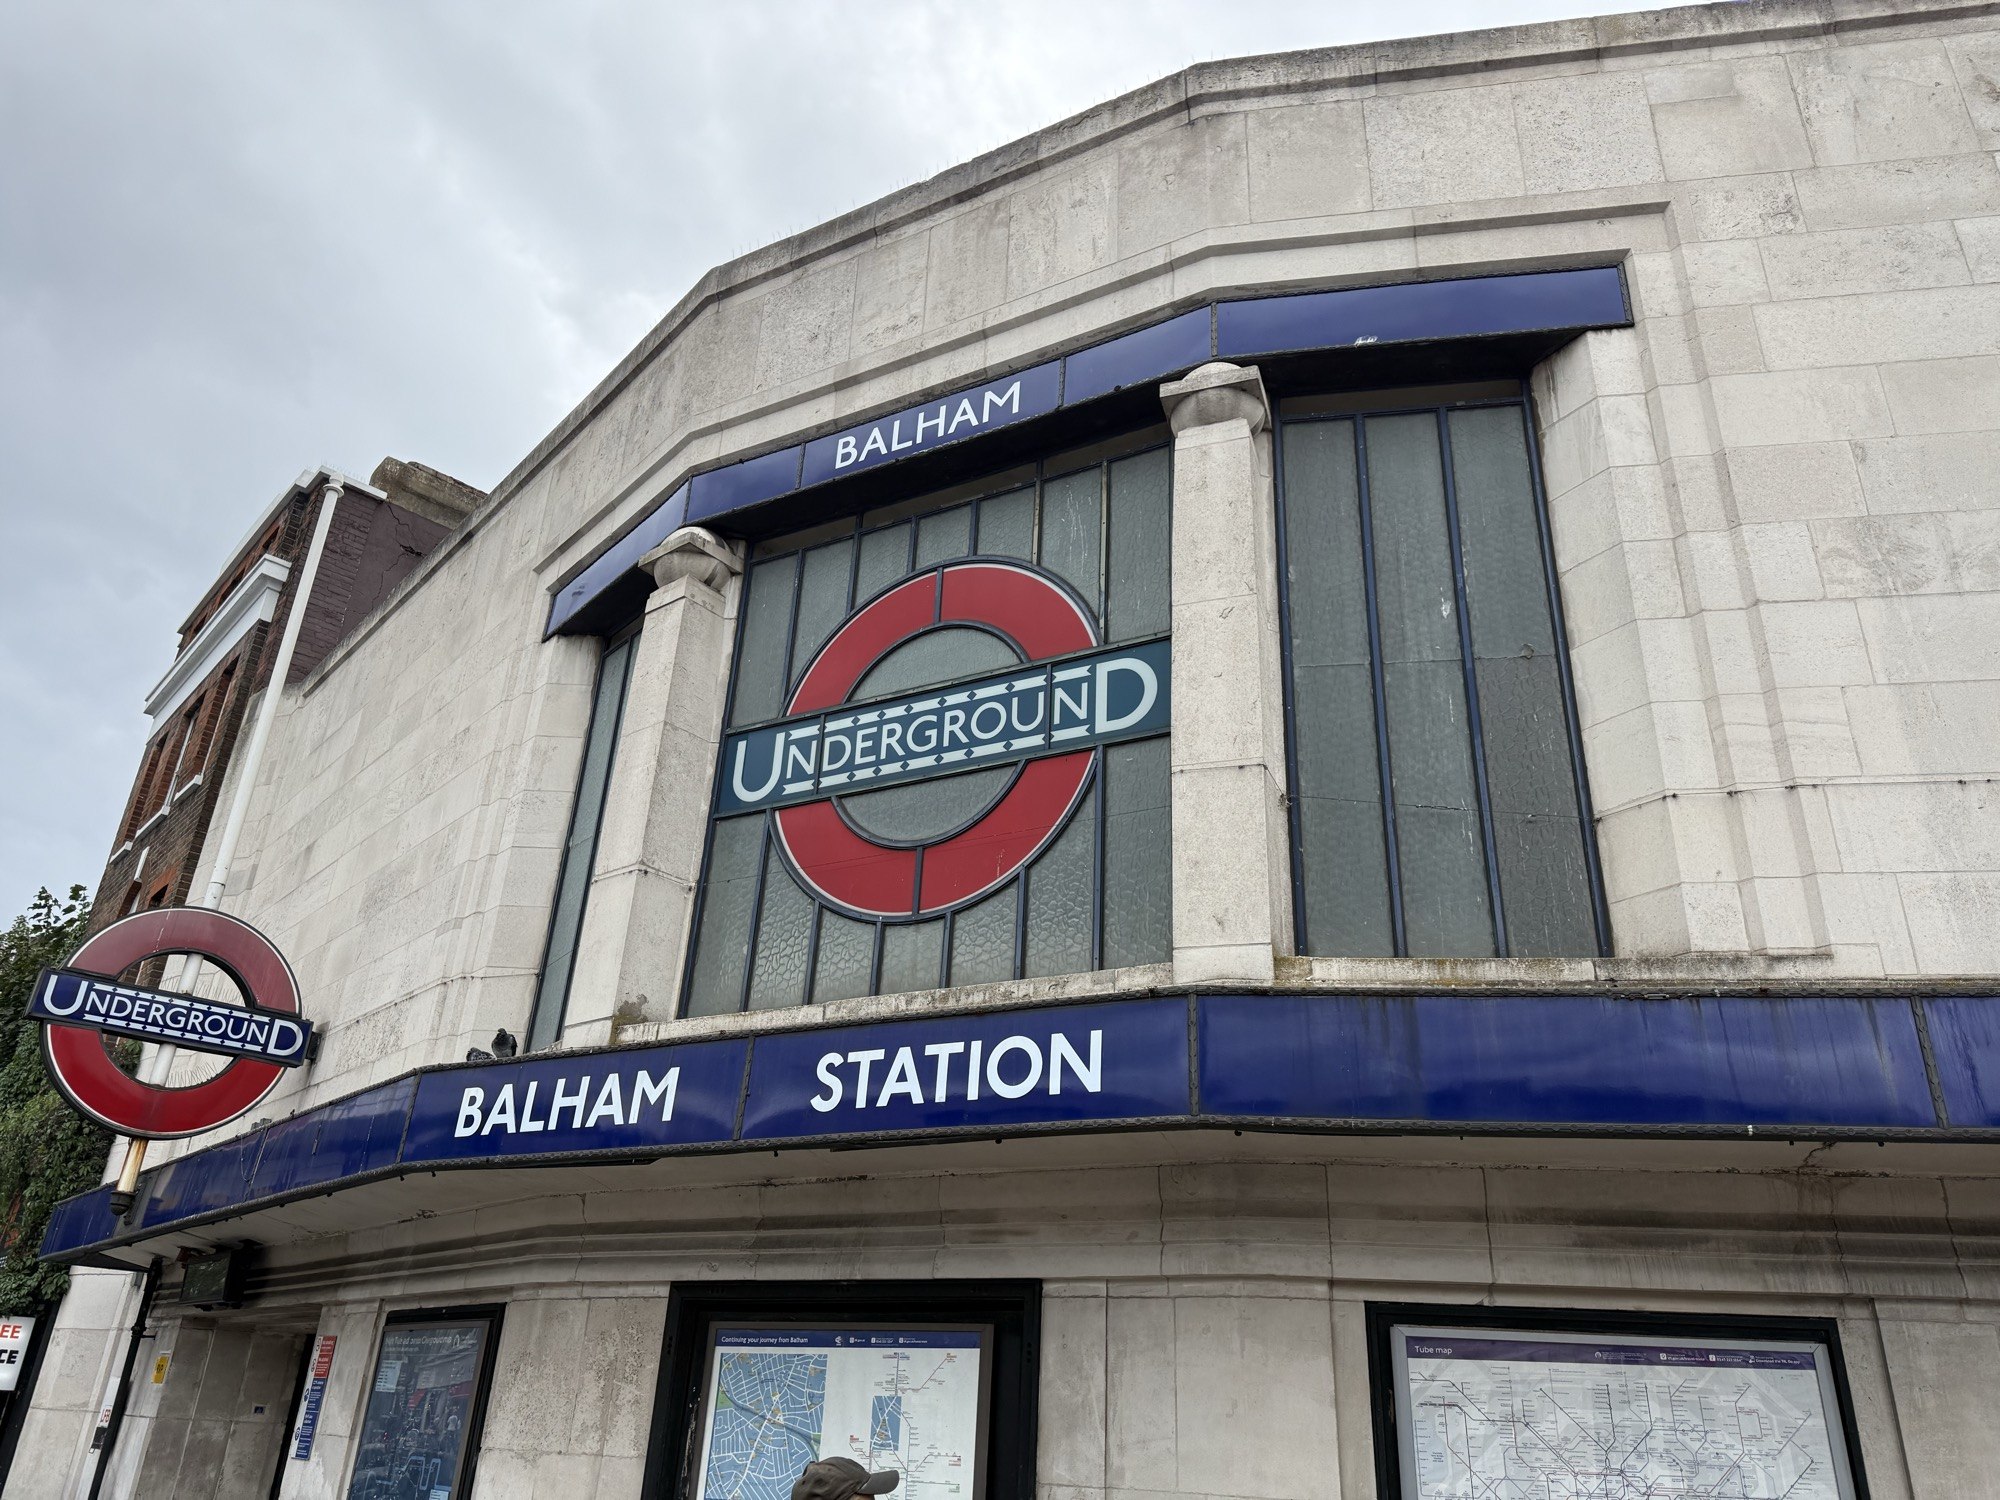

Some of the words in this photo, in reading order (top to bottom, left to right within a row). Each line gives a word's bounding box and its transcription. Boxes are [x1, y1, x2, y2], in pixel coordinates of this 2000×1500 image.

[835, 380, 1021, 469] BALHAM
[732, 657, 1158, 803] UNDERGROUND
[43, 974, 303, 1056] UNDERGROUND
[454, 1066, 680, 1138] BALHAM
[810, 1029, 1102, 1112] STATION
[0, 1324, 22, 1339] EE
[721, 1336, 747, 1344] Continuing
